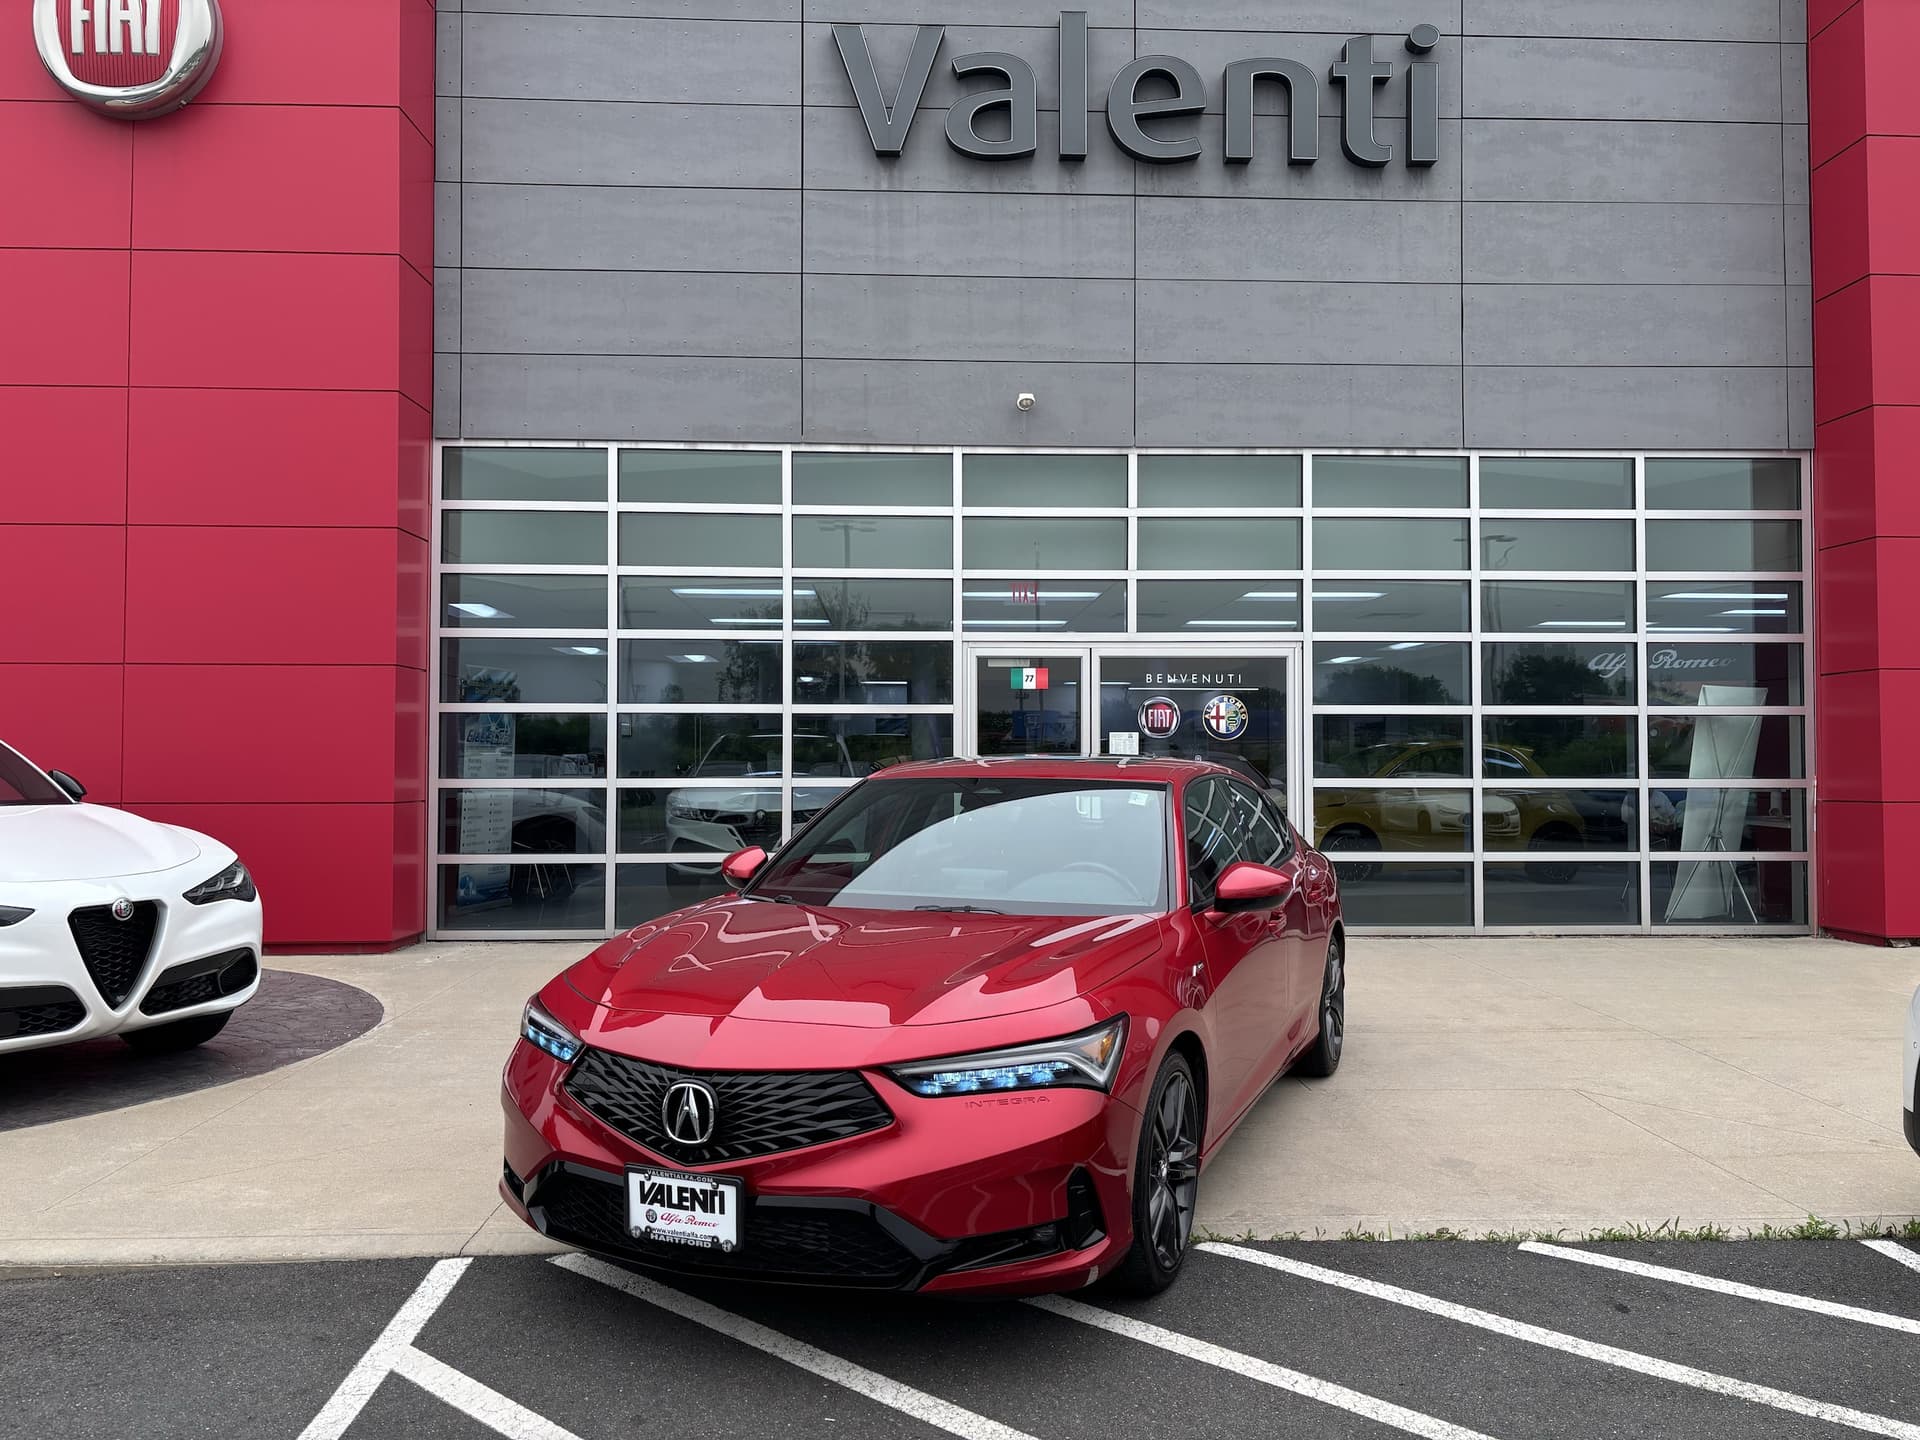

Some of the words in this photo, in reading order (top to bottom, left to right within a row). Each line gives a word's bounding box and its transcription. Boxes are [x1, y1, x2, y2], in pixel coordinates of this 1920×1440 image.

[831, 11, 1440, 168] Valenti
[1588, 652, 1628, 678] Alf
[1025, 674, 1035, 683] 77
[1145, 673, 1242, 684] BENVENUTI
[1147, 708, 1172, 728] FIAT
[965, 1096, 1051, 1109] INTEGRA
[647, 1169, 713, 1183] VALENTIALFA.COM
[639, 1180, 726, 1215] VALENTI
[660, 1211, 682, 1226] Alfa
[683, 1214, 719, 1228] Romeo
[650, 1233, 712, 1249] HARTFORD
